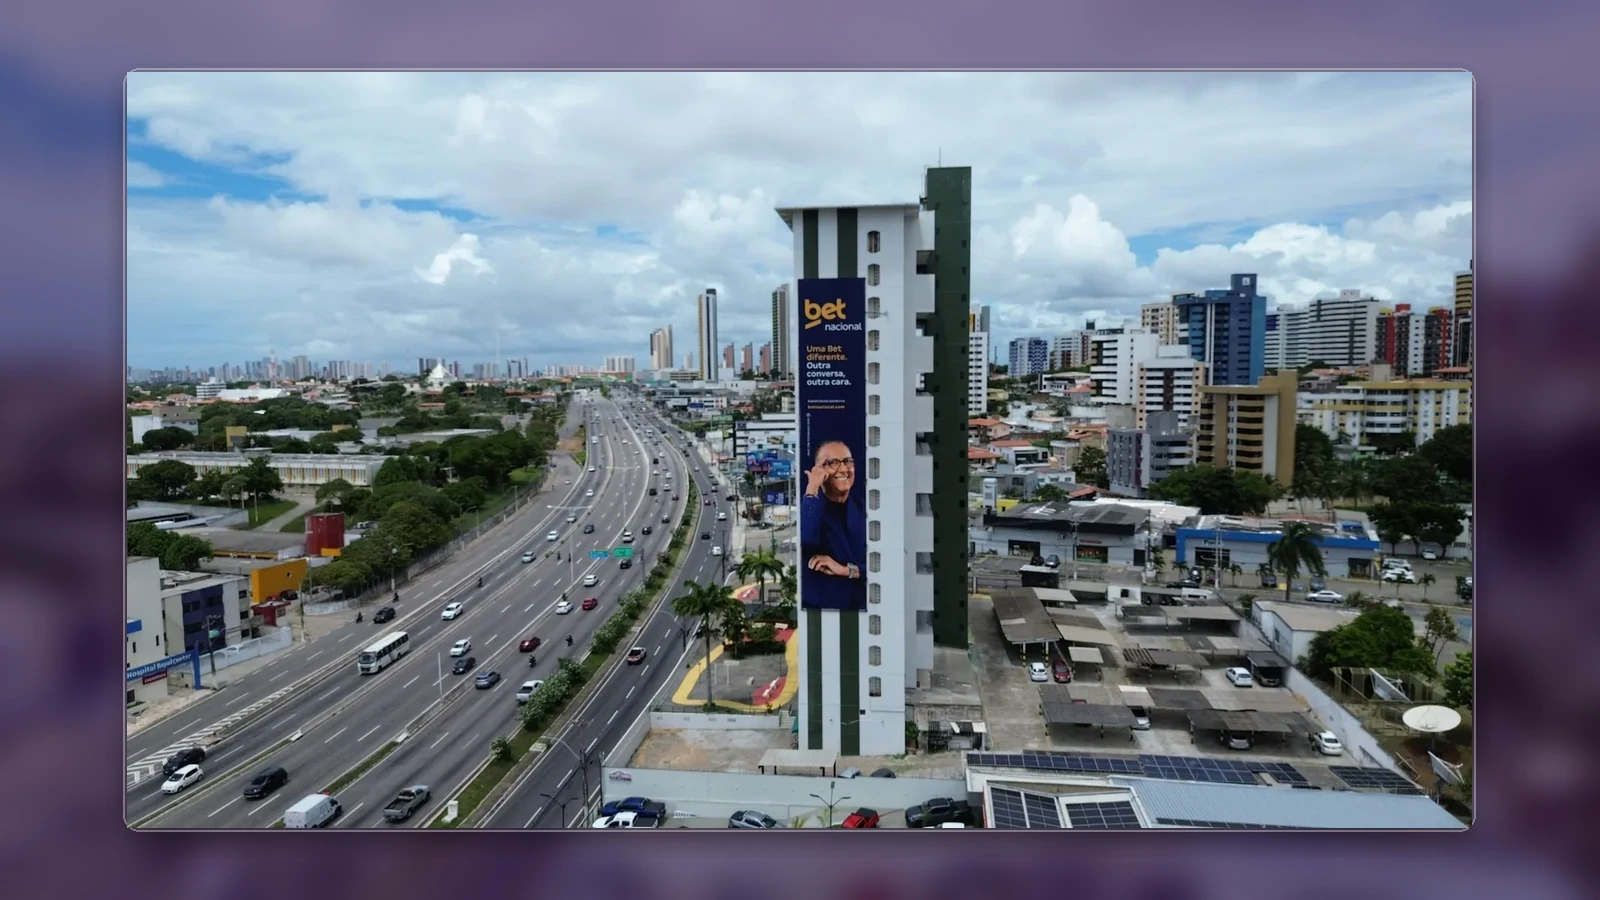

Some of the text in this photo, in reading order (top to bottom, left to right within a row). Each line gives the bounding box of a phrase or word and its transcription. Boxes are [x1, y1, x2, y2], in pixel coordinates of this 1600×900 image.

[804, 298, 846, 329] bet
[824, 322, 862, 331] nacional
[806, 353, 848, 361] diferente.
[127, 664, 156, 679] Hospital
